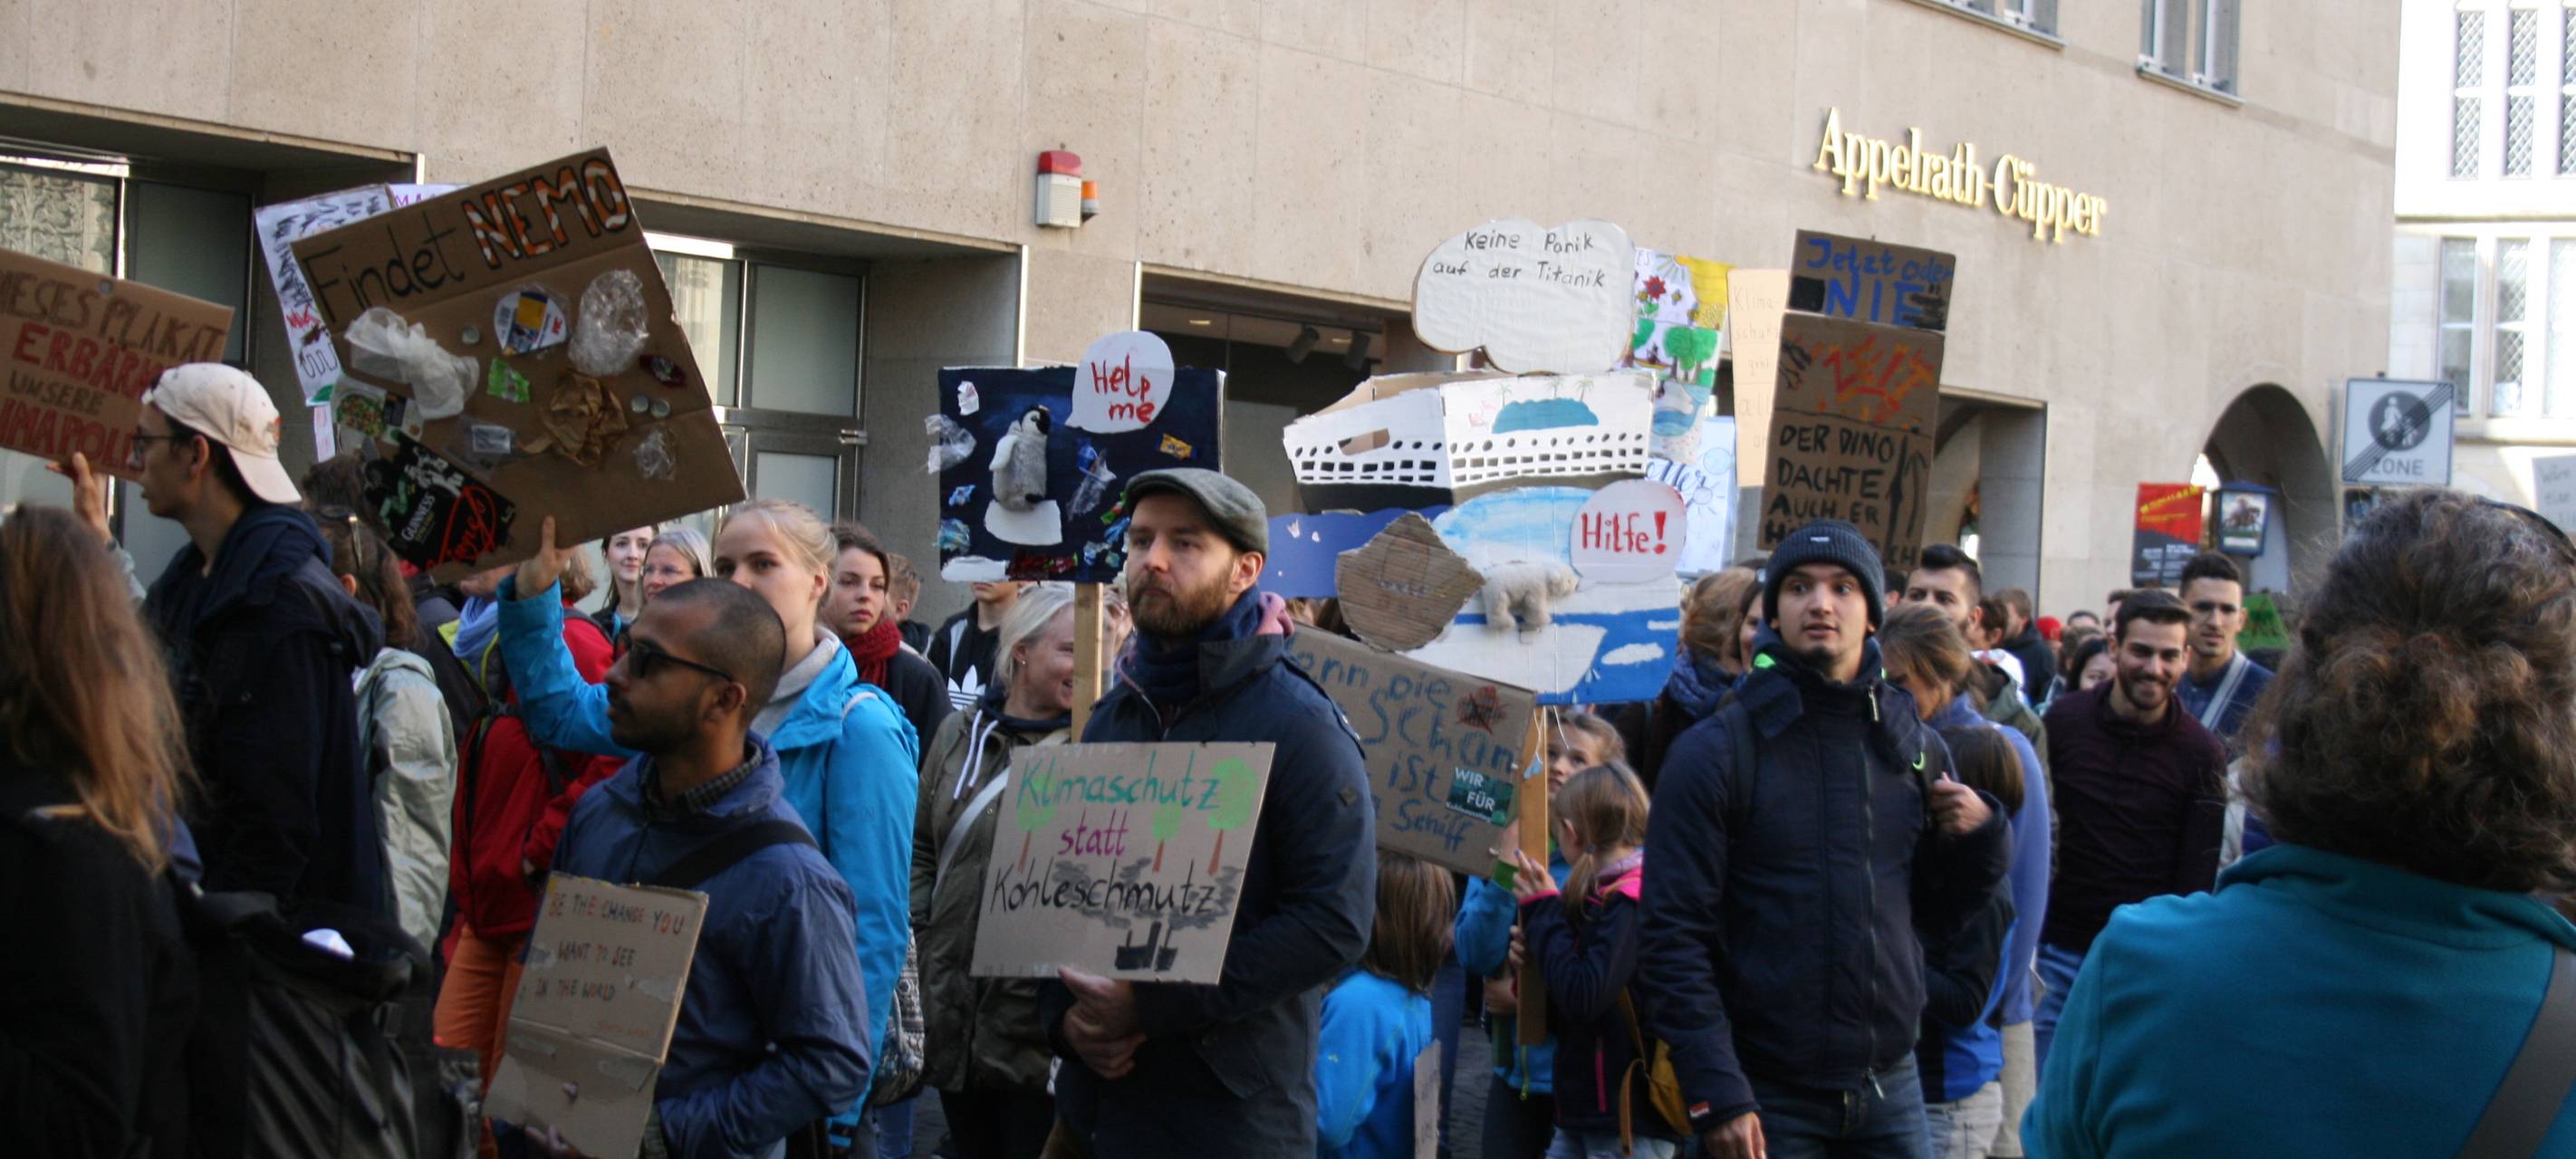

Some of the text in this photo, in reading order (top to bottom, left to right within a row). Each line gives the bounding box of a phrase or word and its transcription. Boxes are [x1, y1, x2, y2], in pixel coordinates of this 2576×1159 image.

[1813, 106, 2107, 244] Appelrath-Cüpper
[302, 211, 466, 323] Findet
[462, 157, 632, 270] NEMO
[1464, 230, 1594, 254] Keine Panik
[1806, 237, 1896, 276] Jetzt
[1432, 260, 1606, 288] auf der Titanik
[1825, 277, 1925, 328] NIE
[100, 297, 227, 362] PLAKAT
[8, 369, 104, 415] UNSERE
[1091, 354, 1150, 401] Help
[1108, 401, 1156, 423] me
[1780, 425, 1894, 463] DER DINO
[2369, 455, 2425, 476] ZONE
[1776, 456, 1886, 499] DACHTE
[1581, 510, 1668, 555] Hilfe!
[1847, 503, 1879, 526] ER
[1016, 749, 1221, 811] Klimaschutz
[1455, 767, 1485, 788] WIR
[1466, 790, 1495, 812] FÜR
[1057, 808, 1129, 857] statt
[989, 856, 1216, 915] Kohleschmutz
[548, 891, 686, 936] BE THE CHANGE YOU
[557, 940, 591, 963] WANT
[611, 944, 637, 967] SEE
[557, 978, 579, 1001] THE
[581, 980, 616, 1001] WORLD
